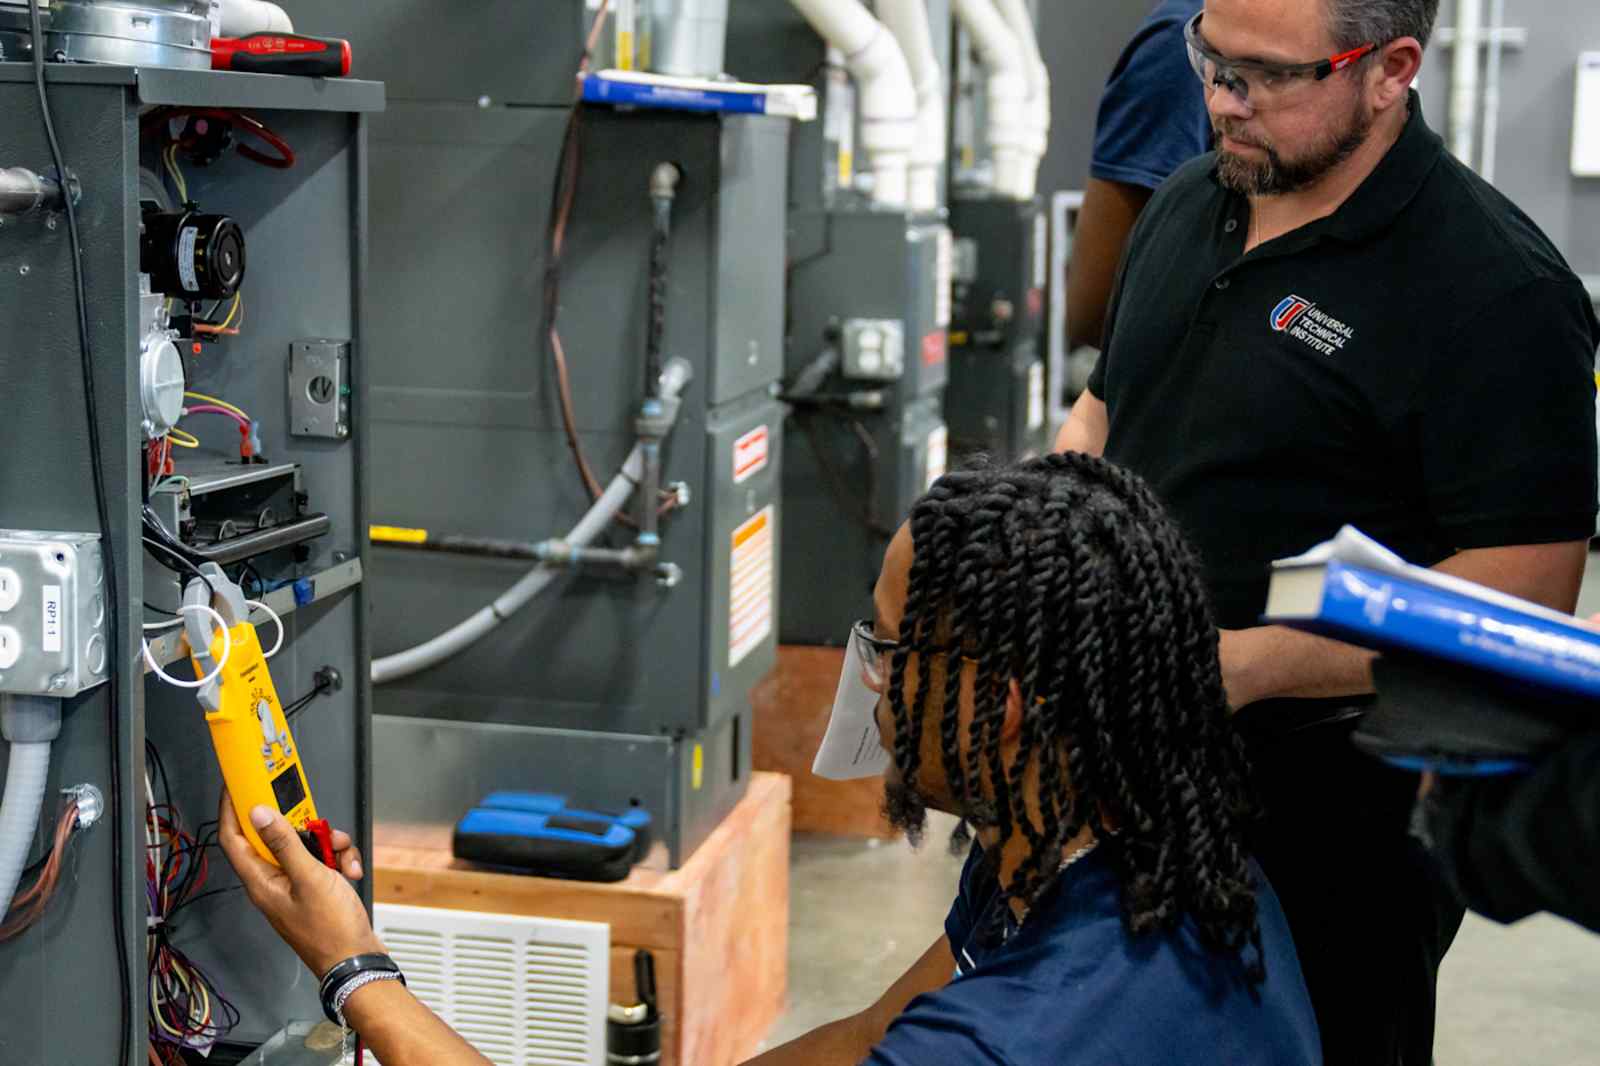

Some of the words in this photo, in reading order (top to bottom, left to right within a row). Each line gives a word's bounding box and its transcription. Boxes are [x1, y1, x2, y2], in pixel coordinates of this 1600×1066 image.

[1299, 315, 1346, 348] TECHNICAL
[1307, 307, 1354, 339] UNIVERSAL
[1290, 325, 1336, 355] INSTITUTE
